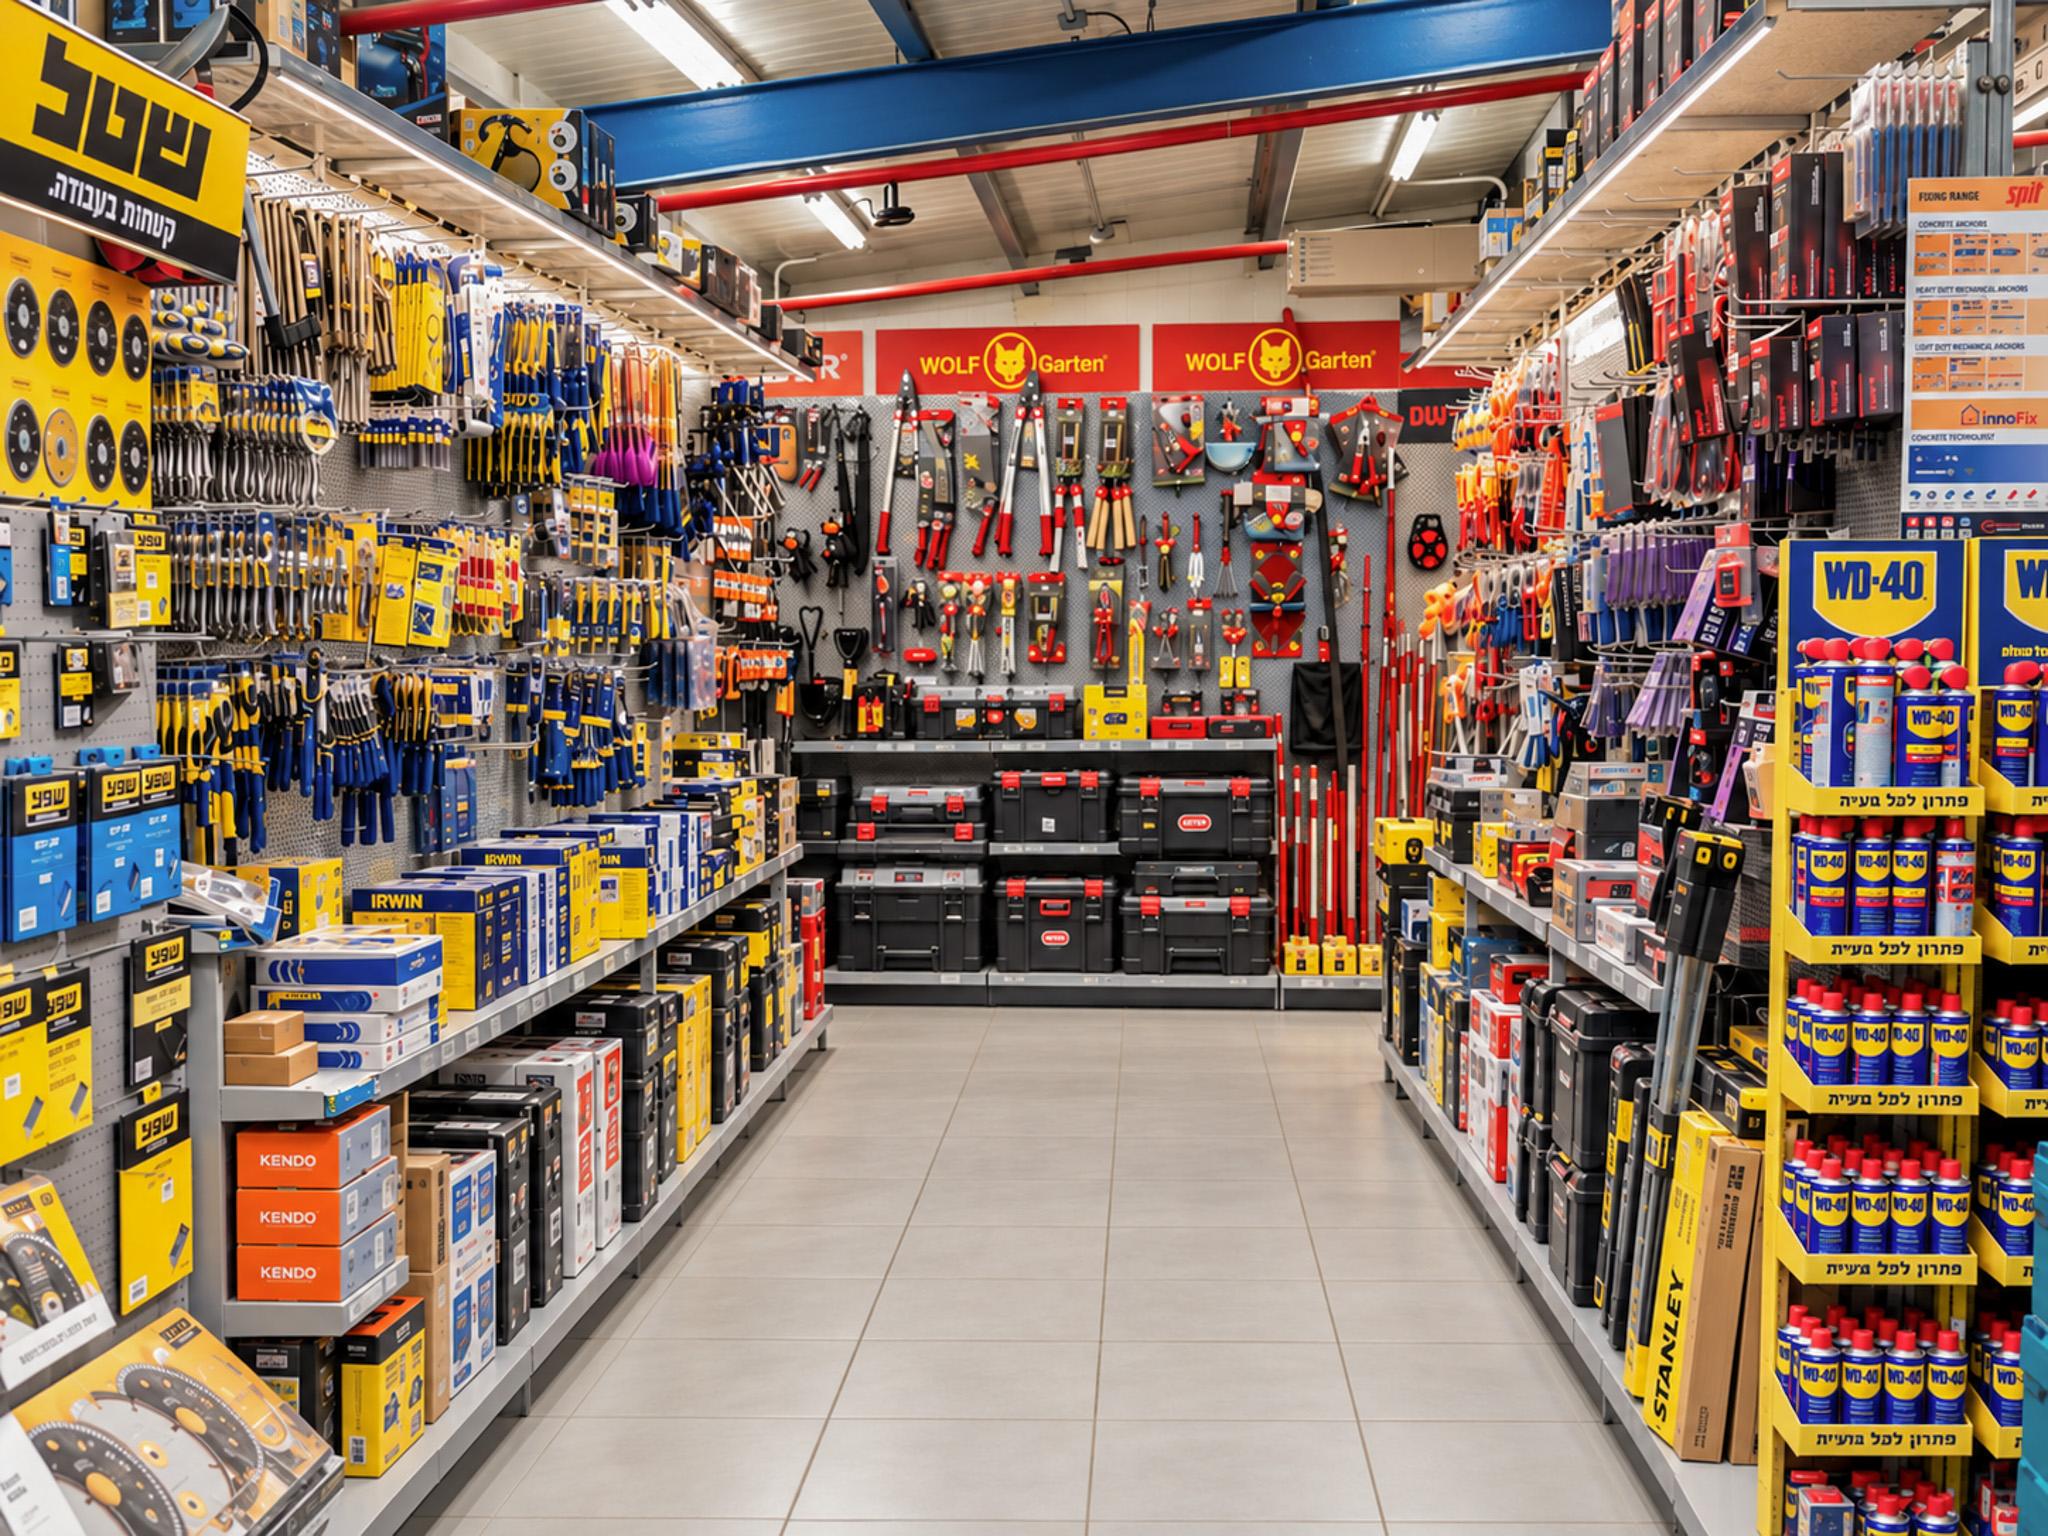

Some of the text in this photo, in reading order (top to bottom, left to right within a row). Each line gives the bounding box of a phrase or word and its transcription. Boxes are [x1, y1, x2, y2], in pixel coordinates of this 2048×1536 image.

[1950, 191, 1979, 200] RANGE
[2006, 182, 2044, 207] spit
[920, 354, 1105, 374] WOLF Garten
[1186, 351, 1372, 371] WOLF Garten
[1983, 411, 2037, 425] innoFix
[1824, 561, 1924, 600] WD-40
[485, 854, 522, 865] IRWIN
[371, 894, 423, 909] IRWIN
[1815, 1028, 1845, 1042] WD-40
[1855, 1028, 1886, 1042] WD-40
[1934, 1028, 1967, 1042] WD-40
[260, 1154, 316, 1168] KENDO
[1816, 1196, 1847, 1211] WD-40
[1855, 1196, 1886, 1211] WD-40
[1894, 1196, 1923, 1211] WD-40
[1936, 1196, 1967, 1212] WD-40
[260, 1211, 316, 1224] KENDO
[261, 1266, 316, 1280] KENDO
[1653, 1269, 1685, 1424] STANLEY
[1803, 1367, 1836, 1382] WD-40
[1845, 1367, 1878, 1384] WD-40
[1888, 1368, 1921, 1384] WD-40
[1931, 1368, 1964, 1384] WD-40
